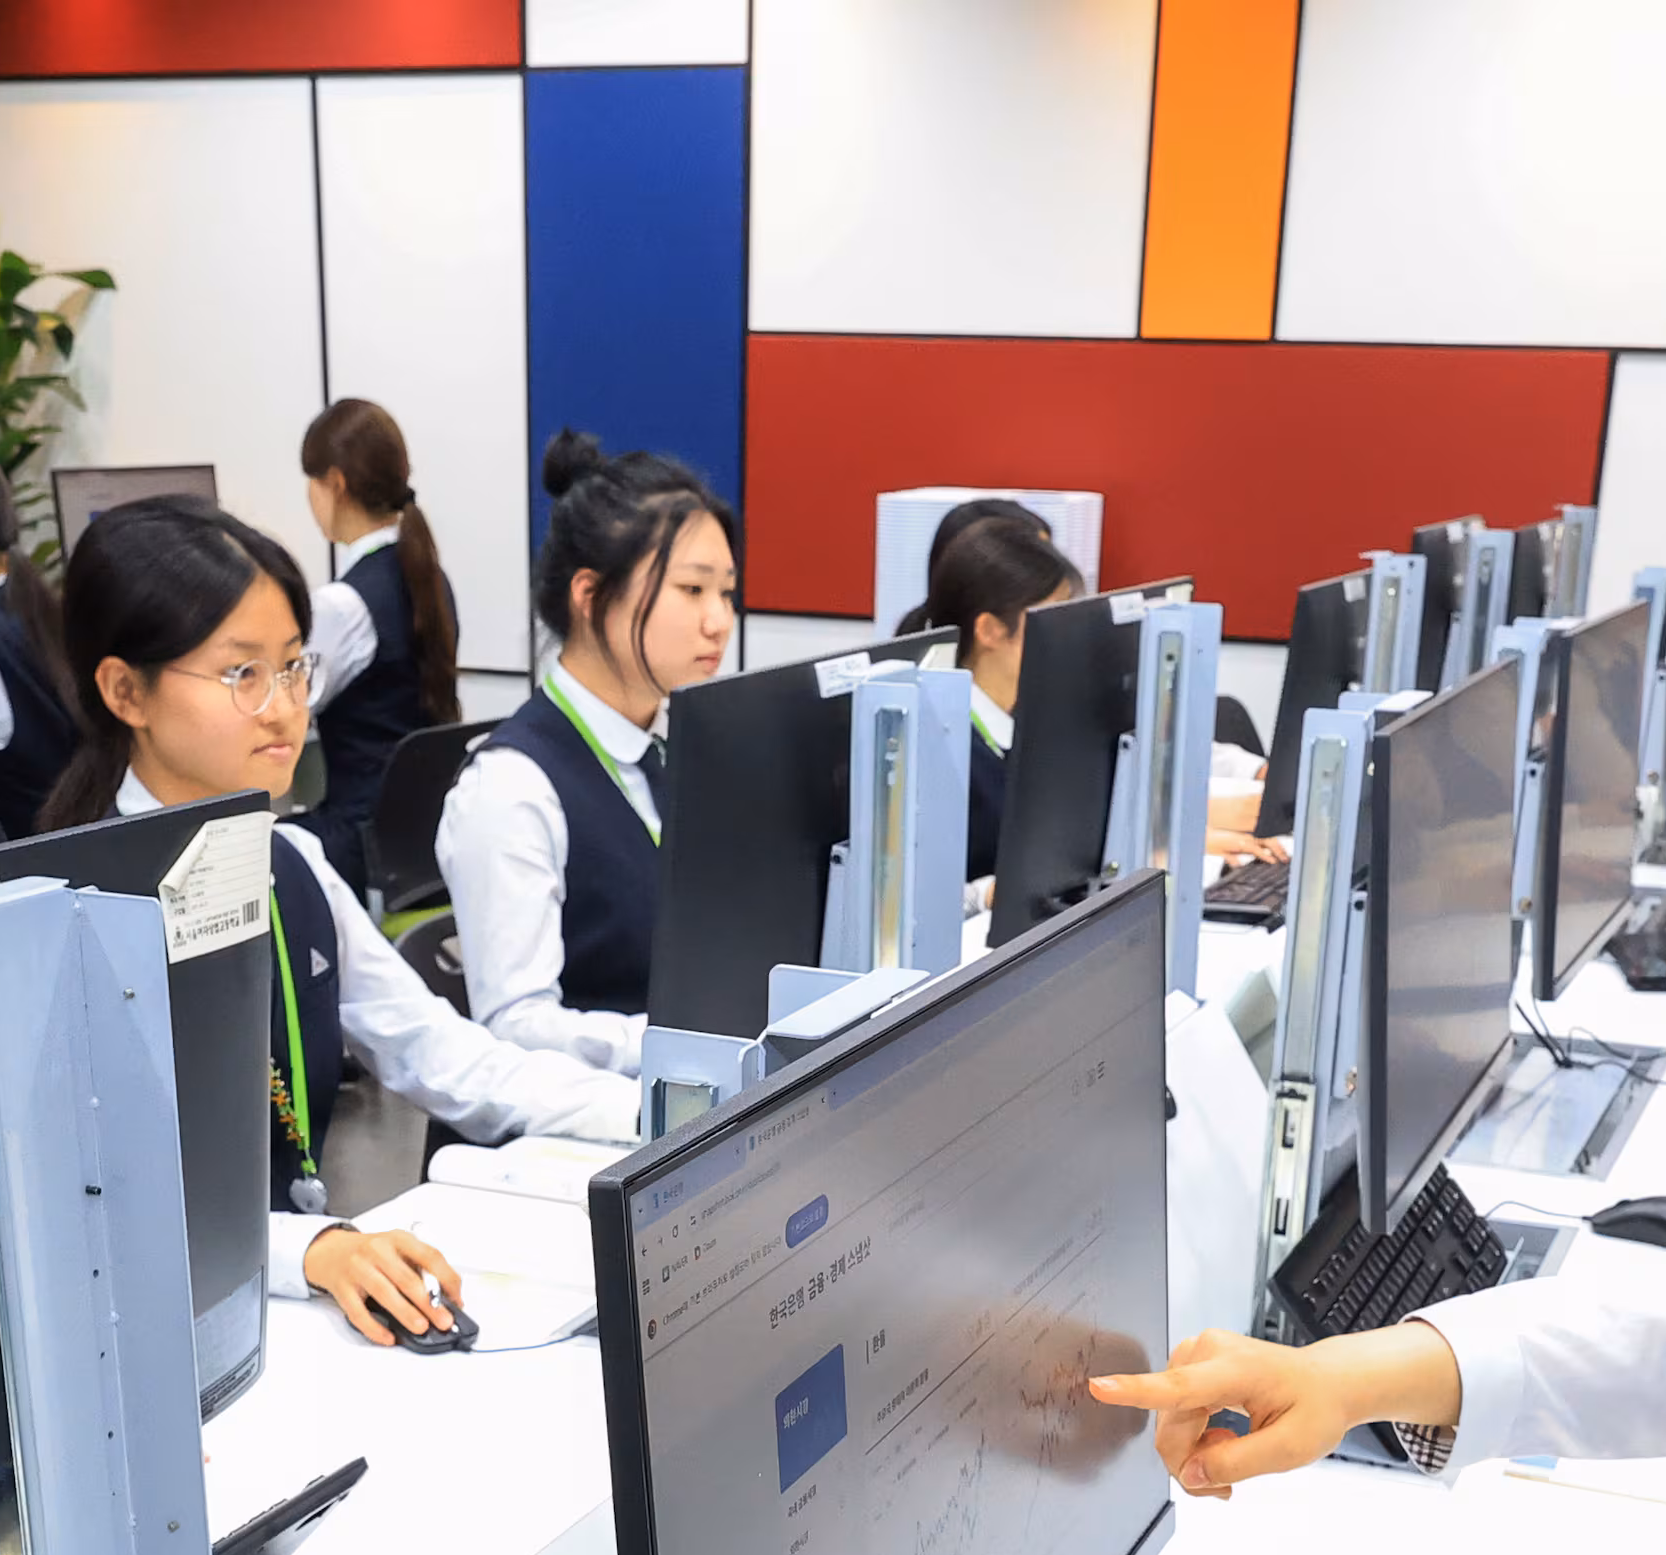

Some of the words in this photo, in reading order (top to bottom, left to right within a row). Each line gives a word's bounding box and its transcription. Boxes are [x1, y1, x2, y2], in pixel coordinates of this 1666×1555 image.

[769, 1286, 805, 1330] 한국은행
[807, 1254, 846, 1301] 금융·경제
[847, 1235, 871, 1270] 스냅샷
[783, 1396, 809, 1430] 외환시장
